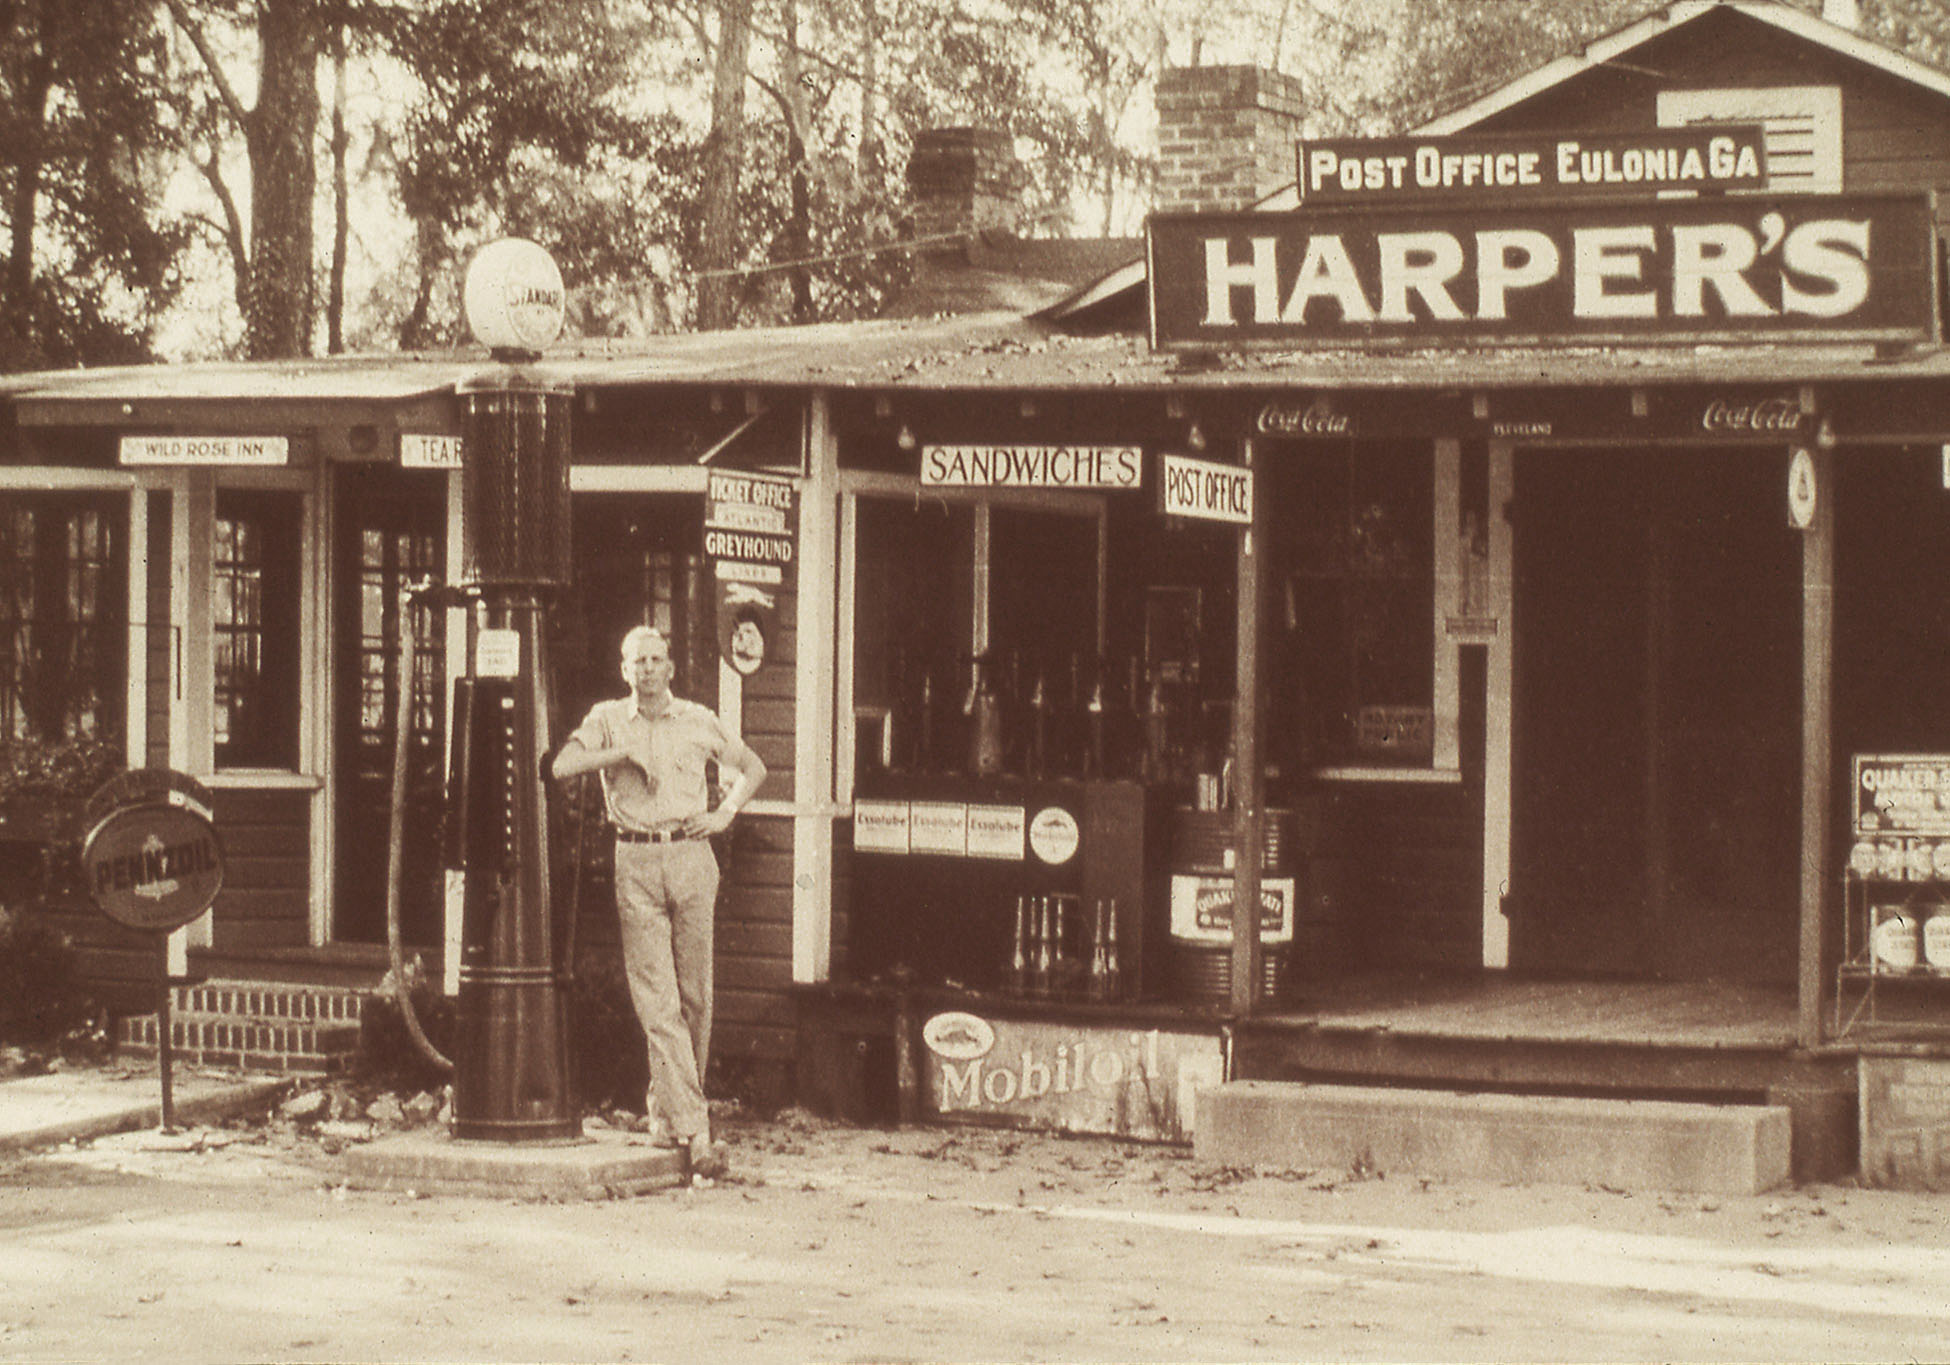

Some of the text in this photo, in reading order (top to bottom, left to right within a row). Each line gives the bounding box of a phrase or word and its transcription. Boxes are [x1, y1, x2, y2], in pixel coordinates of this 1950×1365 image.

[1310, 136, 1759, 191] POST OFFICE EULONIA GA
[1204, 213, 1872, 326] HARPER'S
[145, 441, 264, 457] WILD ROSE INN
[929, 447, 1137, 485] SANDWICHES
[710, 475, 792, 509] TICKET OFFICE
[1168, 465, 1248, 515] POST OFFICE
[705, 532, 793, 562] GREYHOUND
[1861, 768, 1938, 791] QUAKER
[1197, 889, 1235, 913] QUAK
[939, 1028, 1161, 1113] Mobiloil
